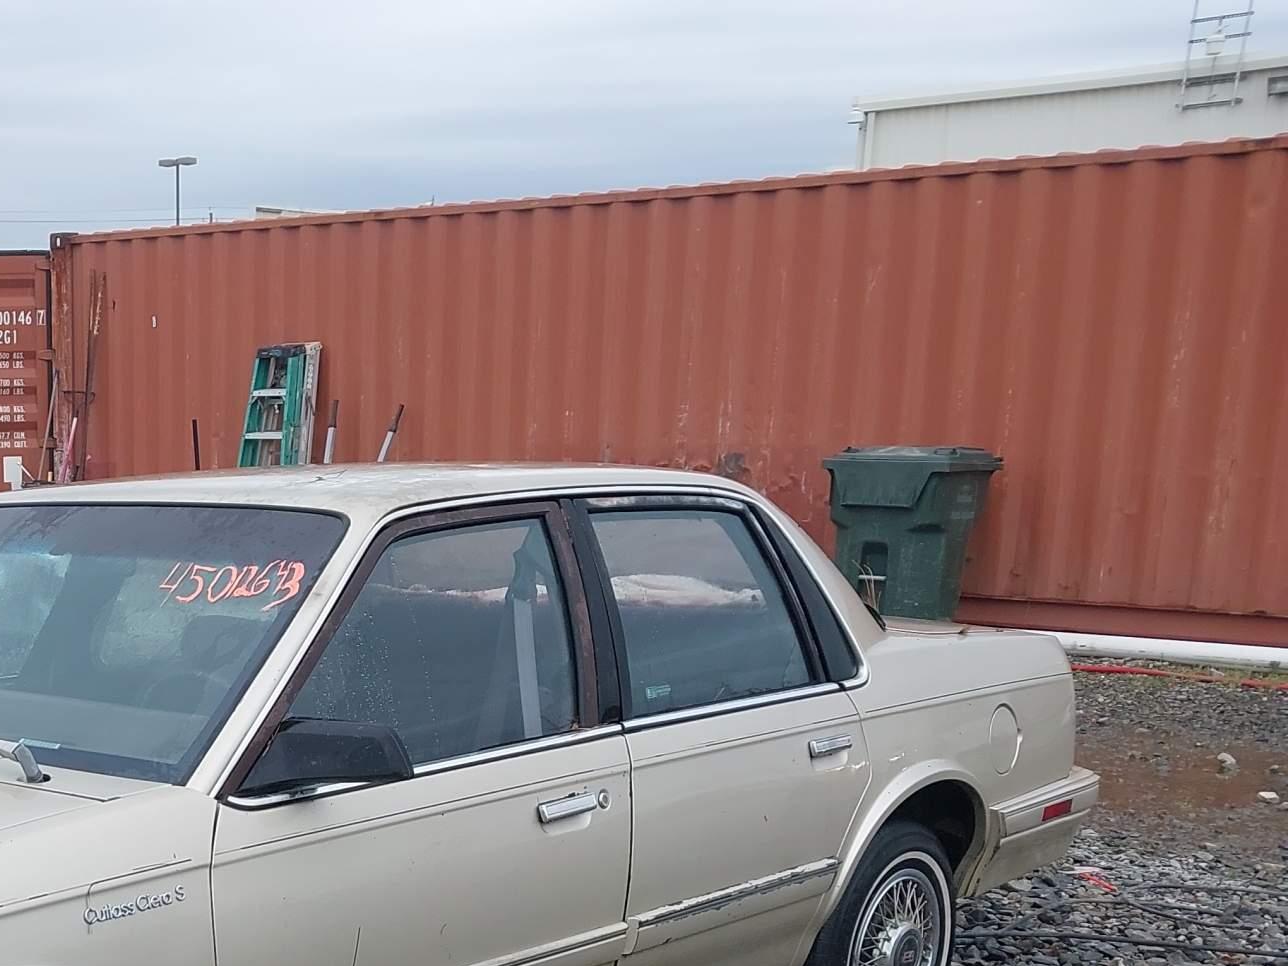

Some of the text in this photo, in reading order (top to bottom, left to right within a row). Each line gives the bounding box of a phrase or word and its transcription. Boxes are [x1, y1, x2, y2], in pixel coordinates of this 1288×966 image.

[36, 309, 47, 326] 7
[159, 559, 305, 612] 45012643
[174, 884, 186, 902] S
